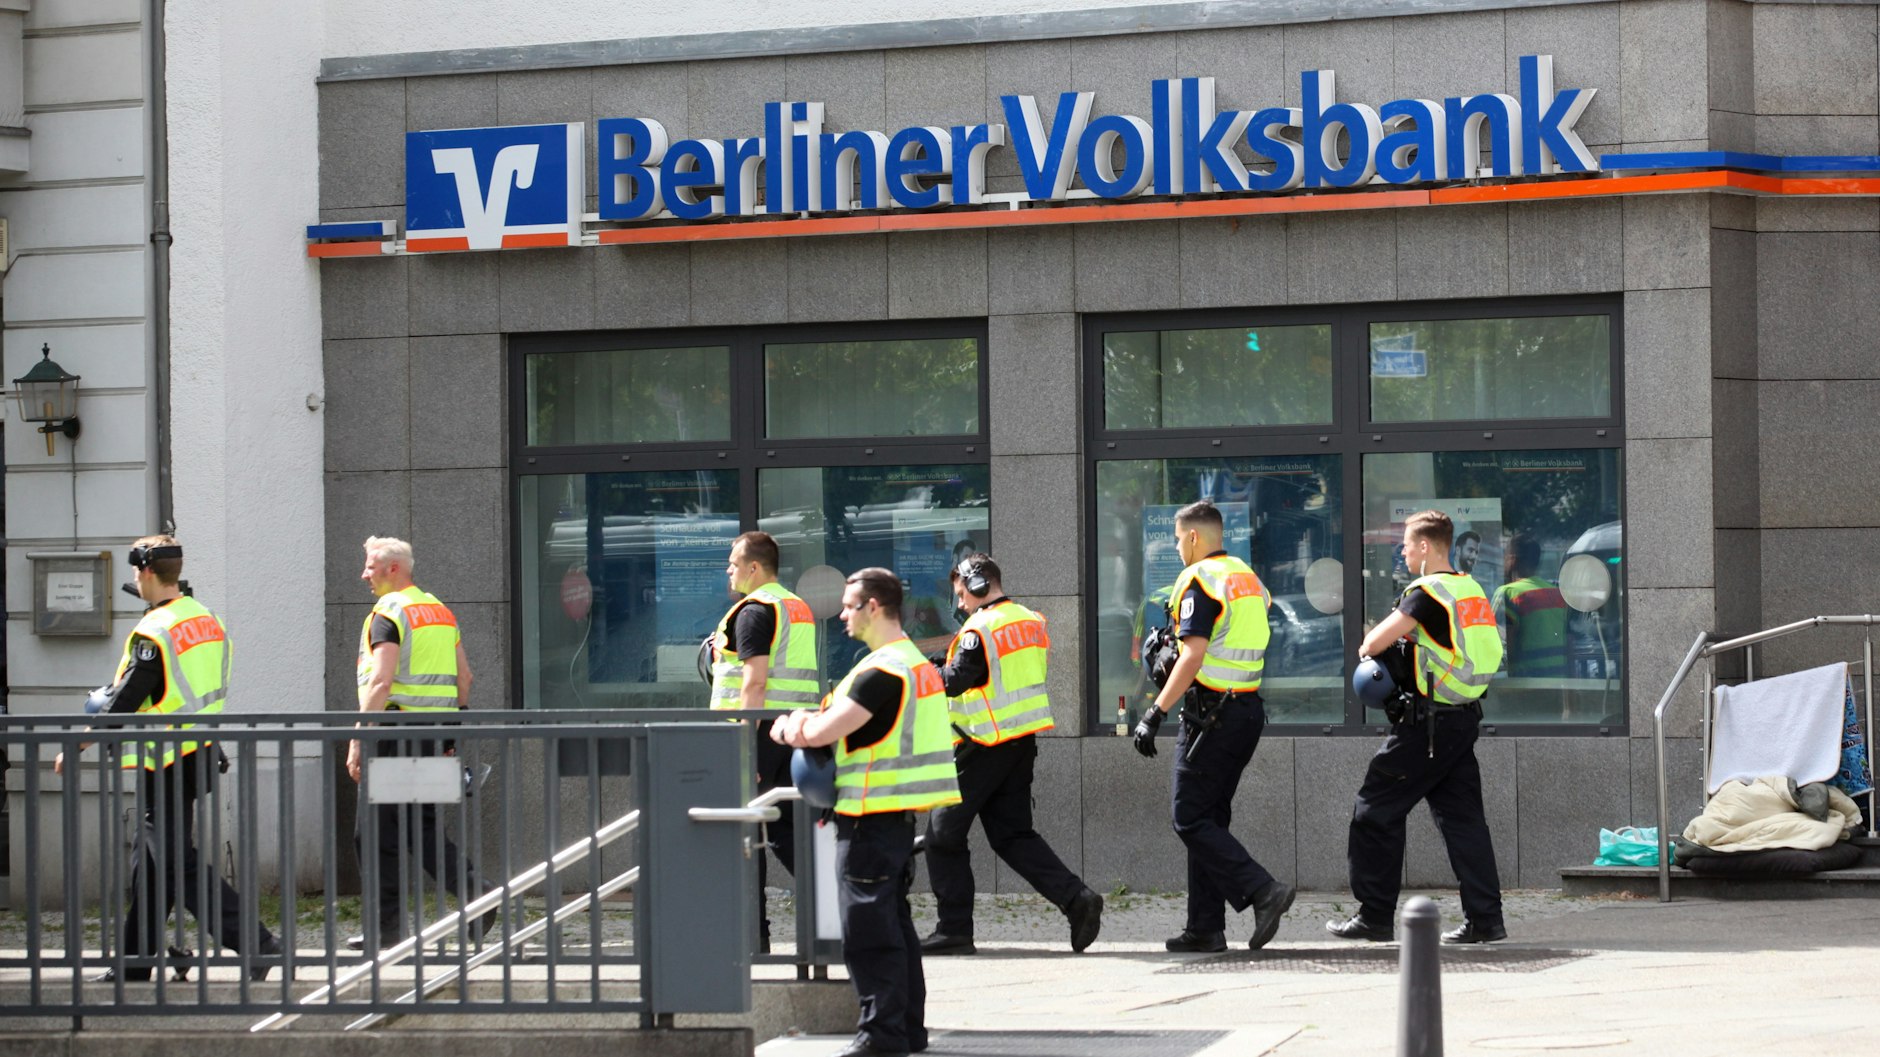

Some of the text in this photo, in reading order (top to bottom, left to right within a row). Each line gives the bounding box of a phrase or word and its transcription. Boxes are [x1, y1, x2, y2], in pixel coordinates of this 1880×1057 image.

[599, 101, 1003, 221] Berliner
[1001, 55, 1597, 200] Volksbank
[1250, 463, 1311, 472] Berliner Volksbank
[1547, 459, 1583, 467] Volksbank
[1148, 531, 1168, 540] von
